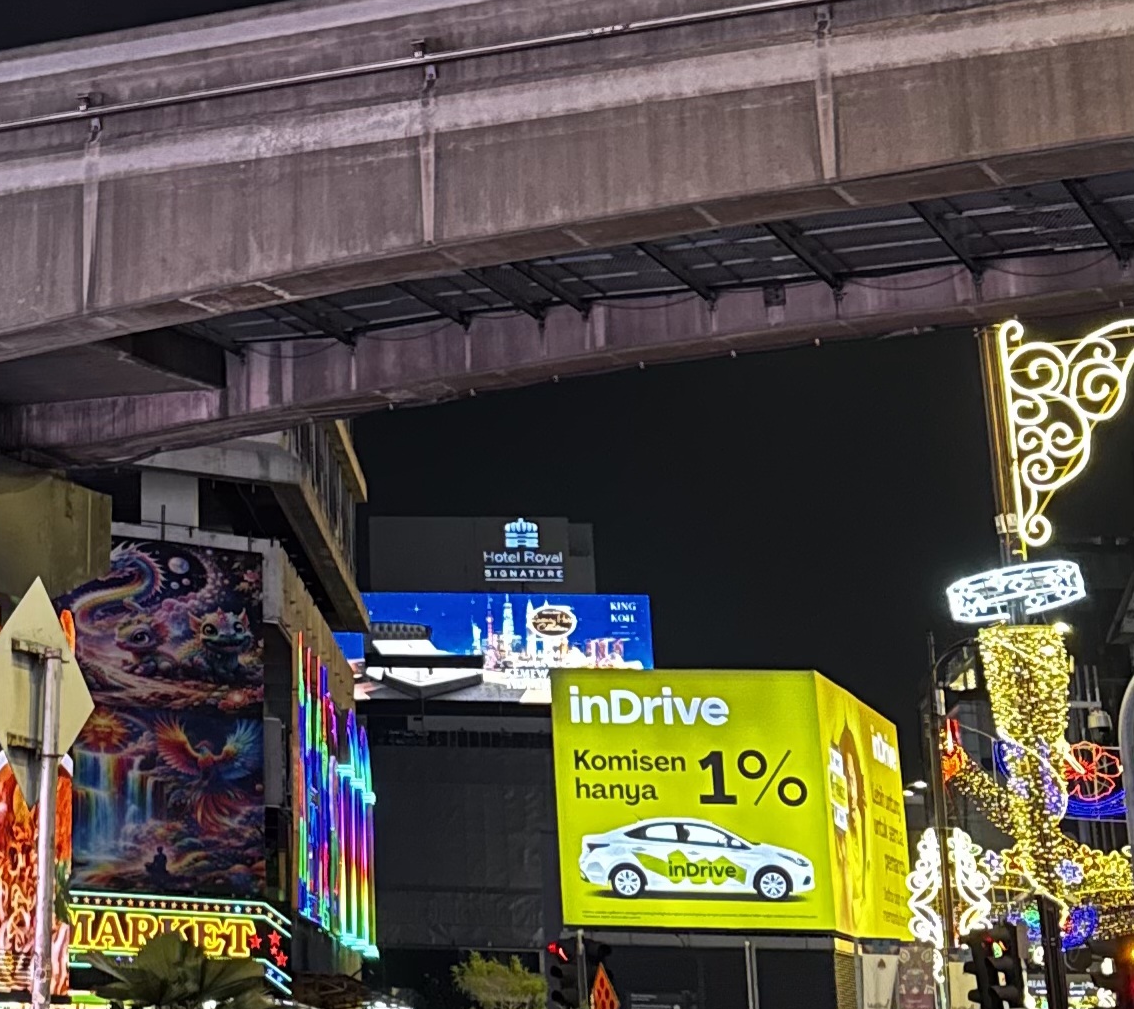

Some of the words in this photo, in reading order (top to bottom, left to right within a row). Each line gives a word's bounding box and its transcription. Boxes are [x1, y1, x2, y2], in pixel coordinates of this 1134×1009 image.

[483, 551, 521, 563] Hotel
[524, 551, 563, 565] Royal
[484, 569, 564, 578] SIGNATURE
[609, 601, 637, 611] KING
[610, 614, 636, 623] KOIL
[569, 686, 730, 726] inDrive
[573, 749, 686, 771] Komisen
[698, 749, 808, 807] 1%
[575, 777, 659, 806] hanya
[668, 860, 737, 878] inDrive
